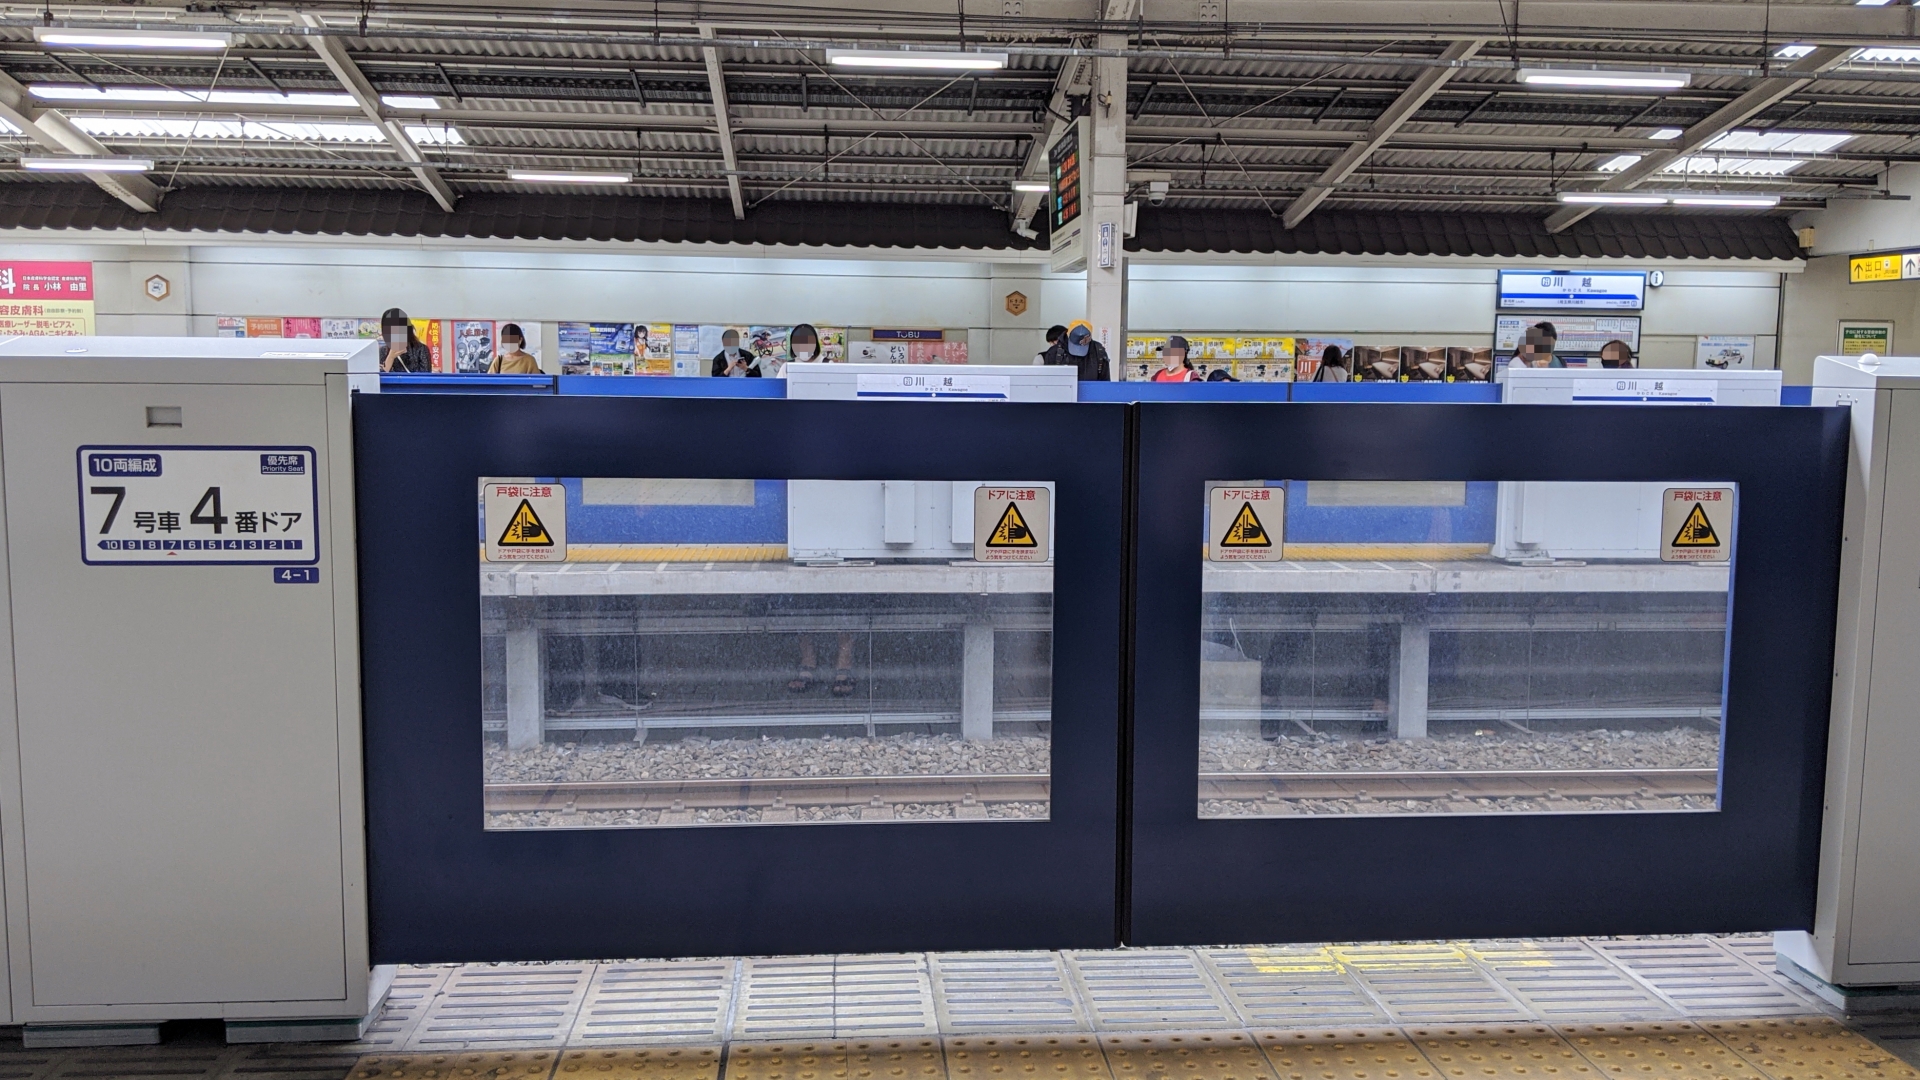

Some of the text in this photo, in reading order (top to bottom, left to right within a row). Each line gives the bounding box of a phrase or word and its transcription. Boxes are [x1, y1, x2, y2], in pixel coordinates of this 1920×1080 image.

[1865, 261, 1882, 272] 出口
[44, 282, 61, 291] 小林
[70, 282, 88, 292] 由里
[250, 323, 278, 331] 予約相談
[93, 458, 157, 473] 10両編成
[267, 455, 298, 466] 優先席
[262, 465, 285, 473] Priority
[496, 486, 552, 498] 戸袋に注意
[988, 490, 1036, 501] ドアに注意
[1223, 489, 1271, 500] ドアに注意
[1673, 490, 1723, 501] 戸袋に注意
[105, 541, 296, 549] 10 9 8 7 6 5 4 3 2 1
[281, 569, 311, 581] 4-1
